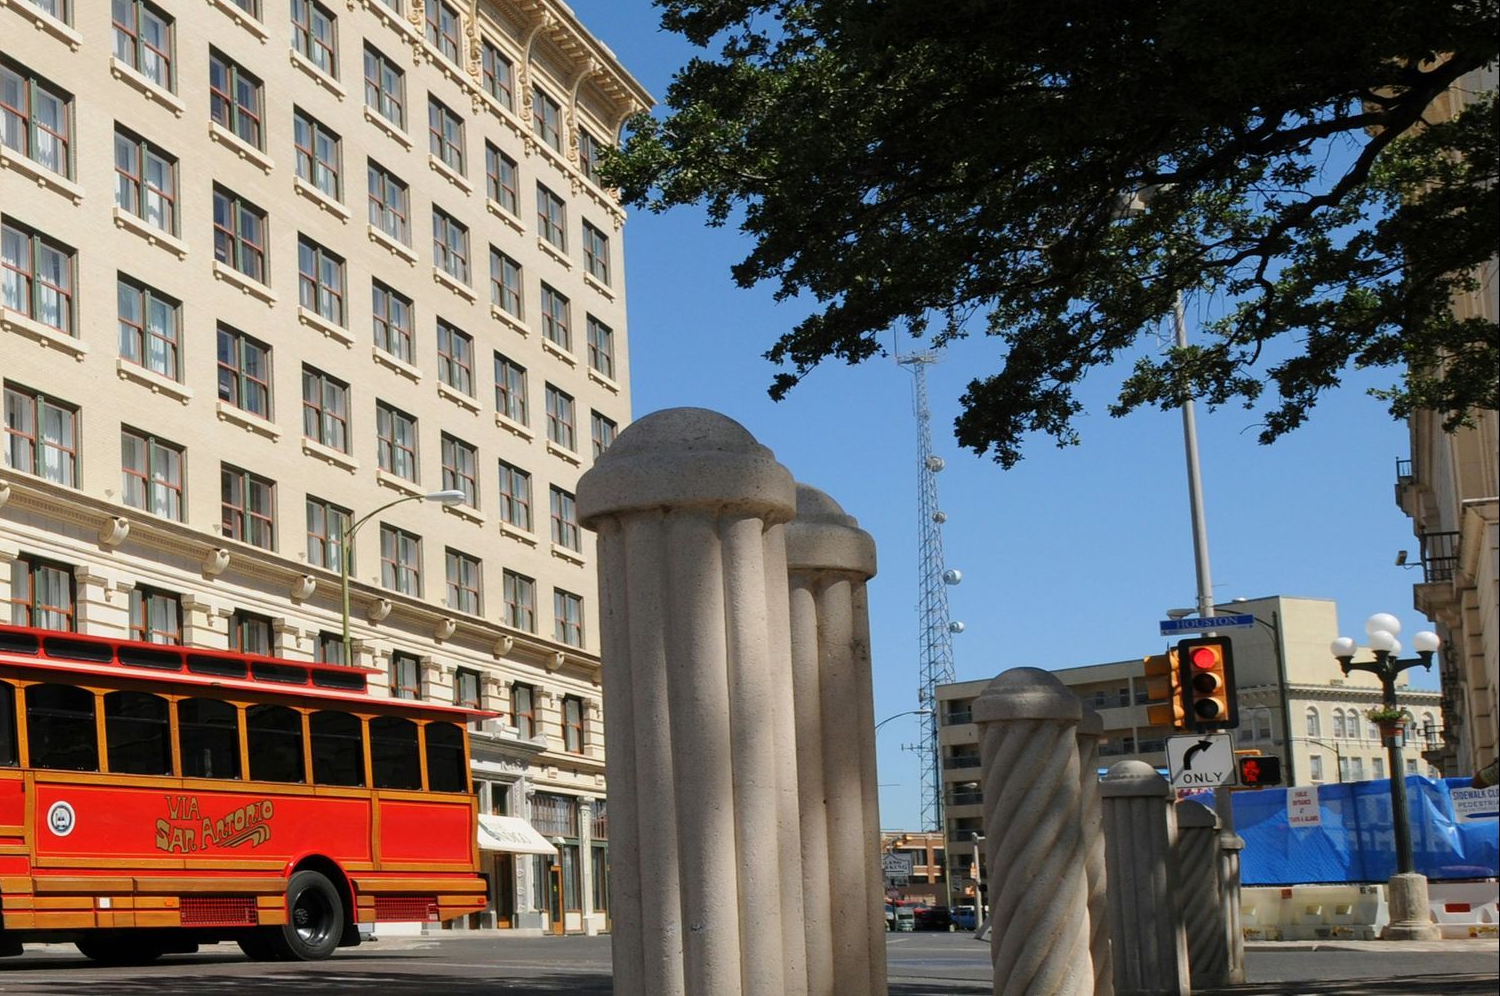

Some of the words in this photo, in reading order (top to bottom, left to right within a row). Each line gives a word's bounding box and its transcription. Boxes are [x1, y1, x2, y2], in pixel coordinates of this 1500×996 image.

[1175, 615, 1238, 629] HOUSTON
[1182, 772, 1223, 784] ONLY
[164, 795, 201, 820] VIA
